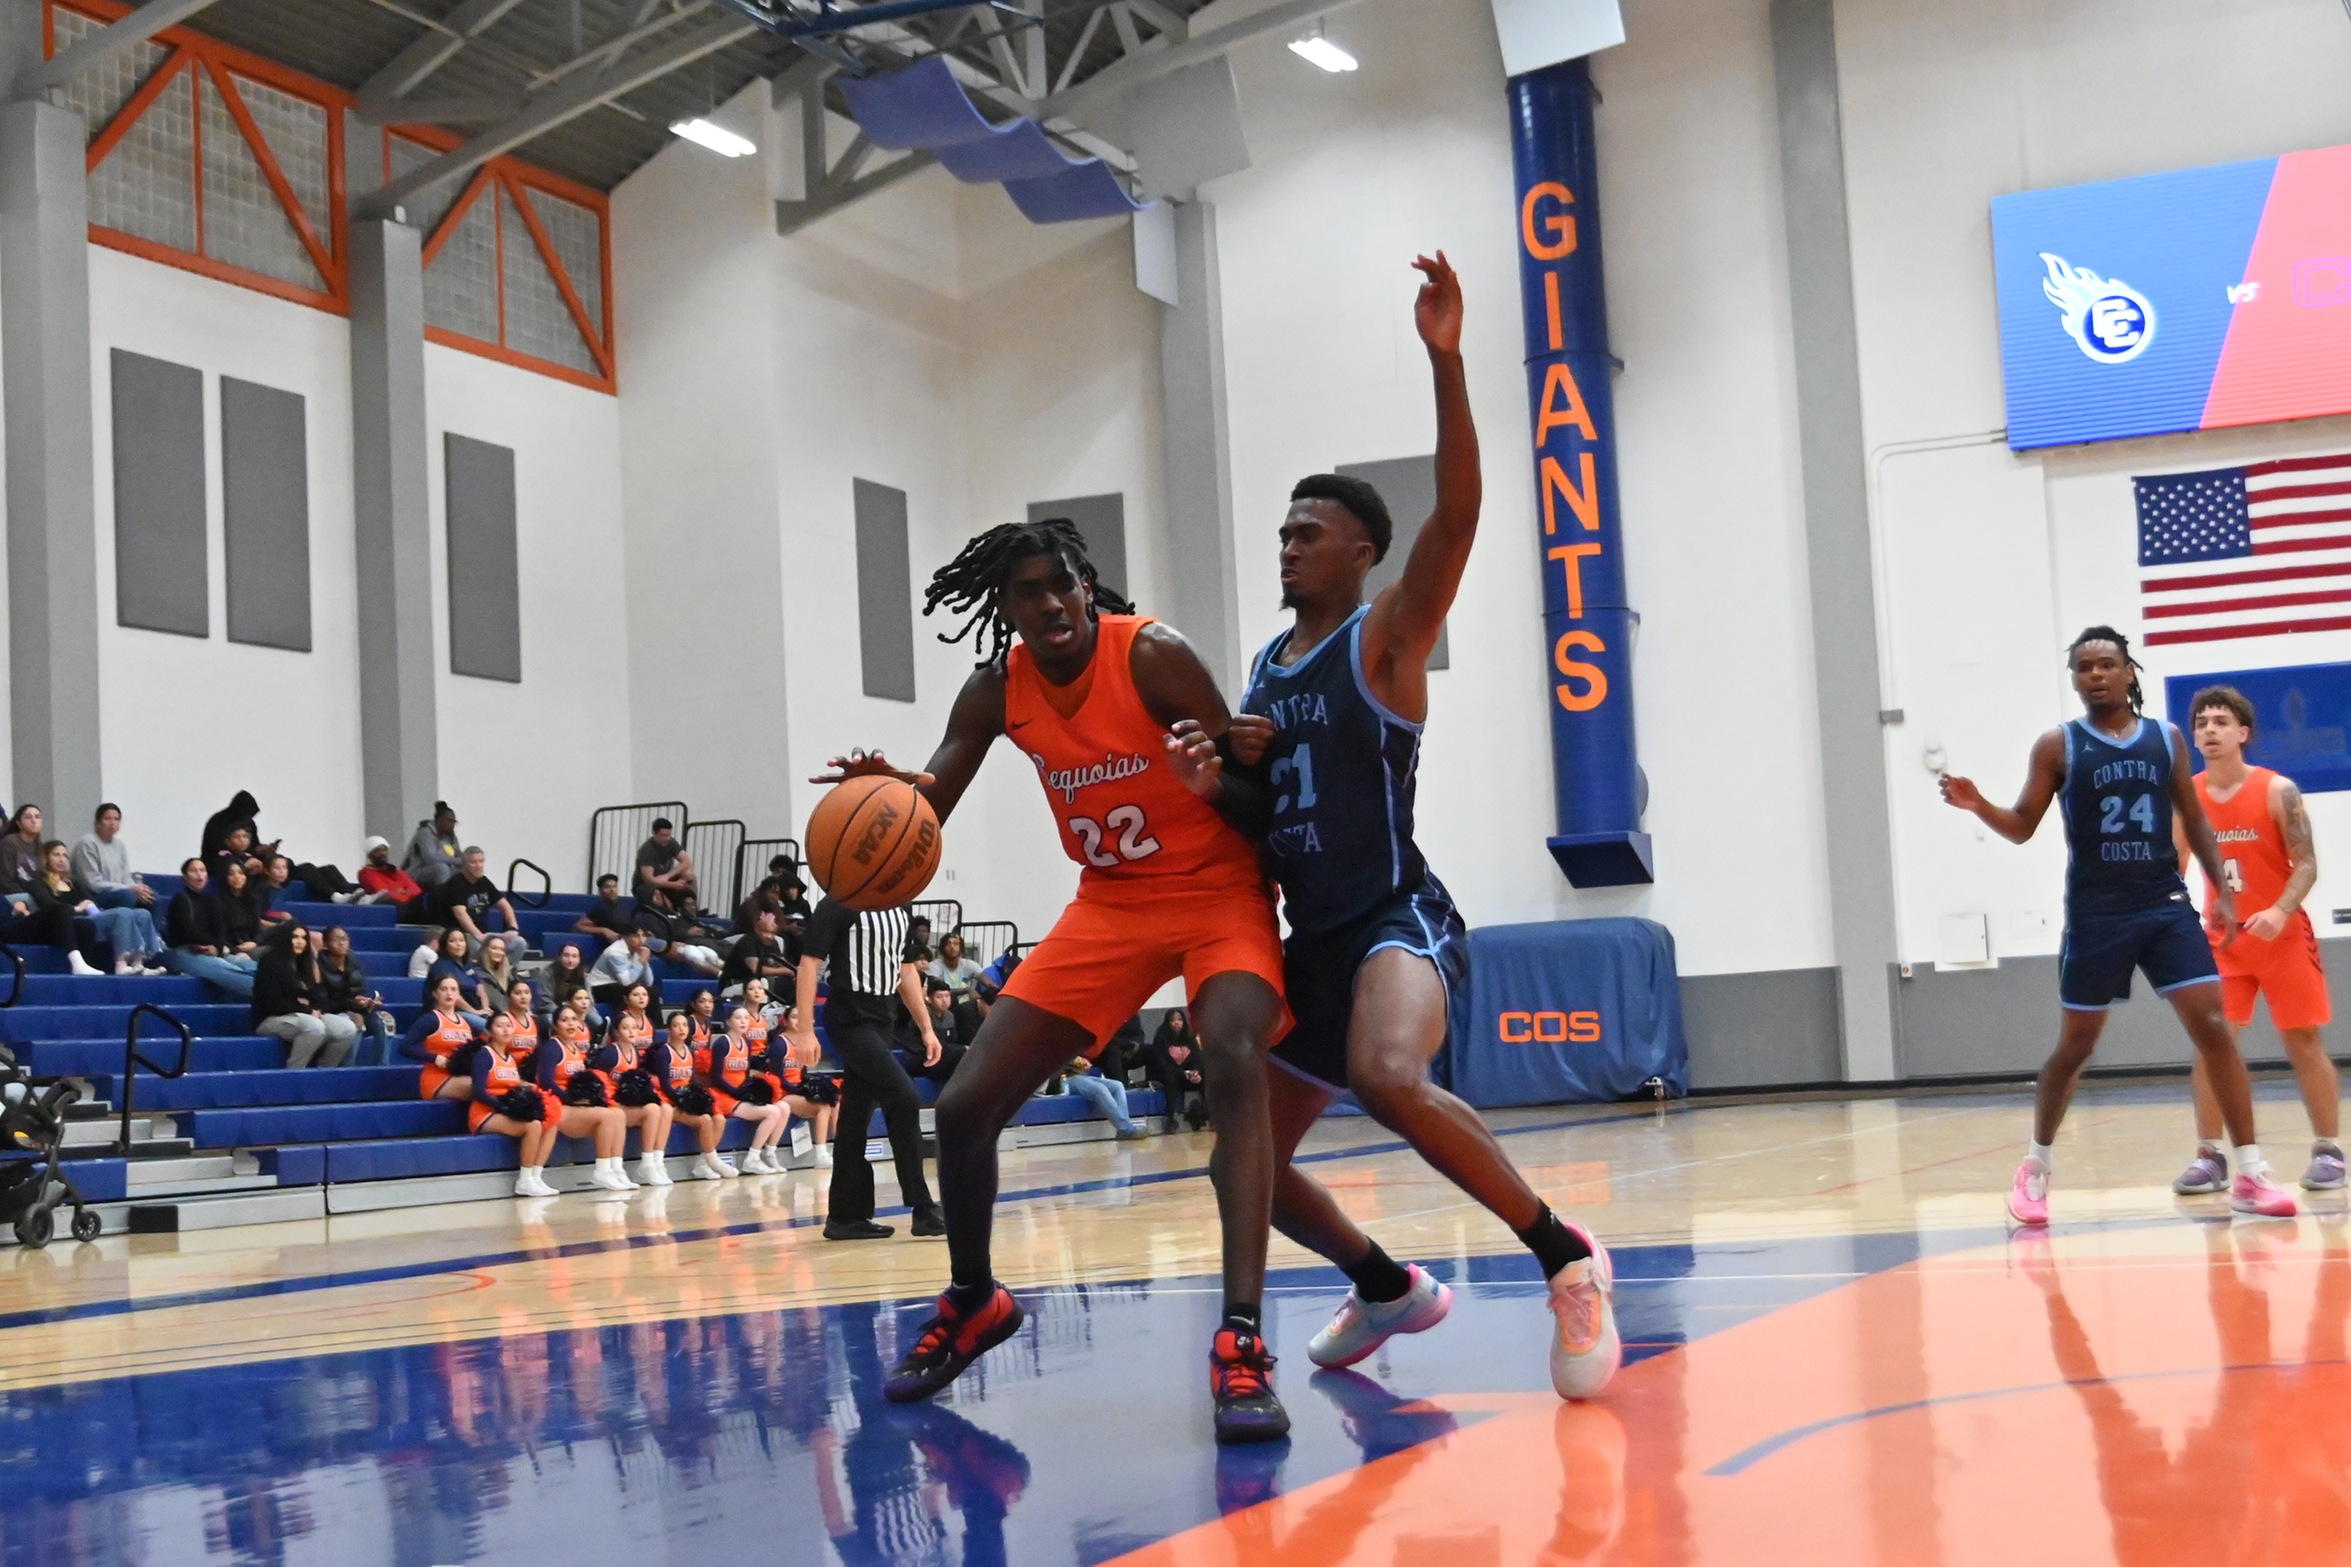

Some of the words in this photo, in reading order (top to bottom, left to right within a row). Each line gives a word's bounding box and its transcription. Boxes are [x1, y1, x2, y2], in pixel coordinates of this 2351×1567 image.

[1520, 181, 1607, 711] GIANTS
[2093, 759, 2158, 789] CONTRA
[851, 801, 899, 865] NCAA
[2100, 793, 2154, 834] 24
[1068, 804, 1161, 867] 22
[2101, 841, 2152, 861] COSTA
[1499, 1011, 1601, 1042] COS
